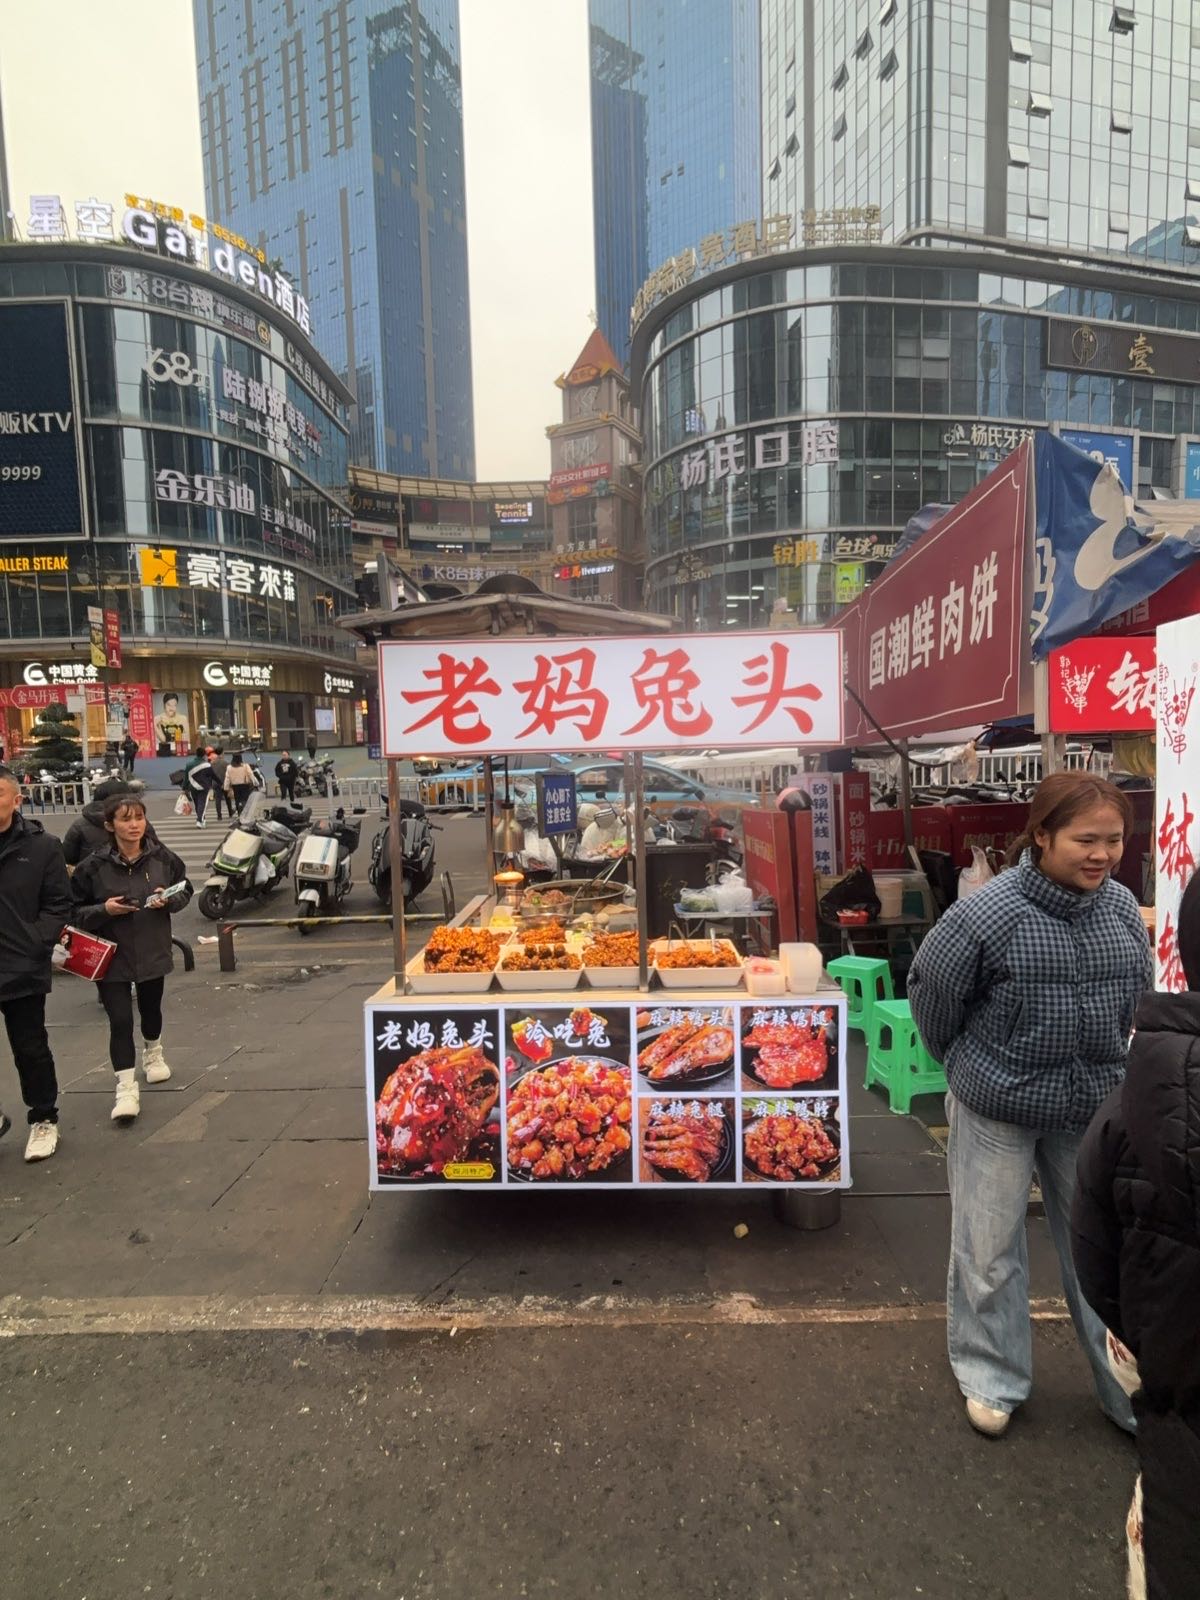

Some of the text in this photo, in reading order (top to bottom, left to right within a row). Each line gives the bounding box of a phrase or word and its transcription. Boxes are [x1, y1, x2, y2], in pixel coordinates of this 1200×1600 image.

[27, 195, 114, 240] 星空
[122, 208, 274, 300] Garden
[275, 271, 310, 336] 酒店
[1128, 332, 1154, 374] 壹
[681, 424, 840, 491] 杨氏口腔
[1, 465, 41, 481] 9999
[156, 469, 256, 516] 金乐迪
[495, 510, 527, 518] Tennis
[33, 556, 69, 571] STEAK
[187, 552, 282, 599] 豪客來
[869, 551, 998, 690] 国潮鲜肉饼
[49, 664, 98, 678] 中国黄金
[229, 664, 271, 679] 中国黄金
[255, 678, 270, 687] Gold
[17, 690, 59, 704] 金马开运
[401, 642, 823, 744] 老妈兔头
[546, 806, 571, 824] 注意安全
[812, 784, 830, 838] 砂锅米线
[649, 1010, 724, 1027] 麻辣鸭头
[750, 1010, 829, 1028] 麻辣鸭腿
[376, 1018, 494, 1051] 老妈兔头
[525, 1018, 611, 1048] 冷吃兔
[648, 1101, 726, 1119] 麻辣兔腿
